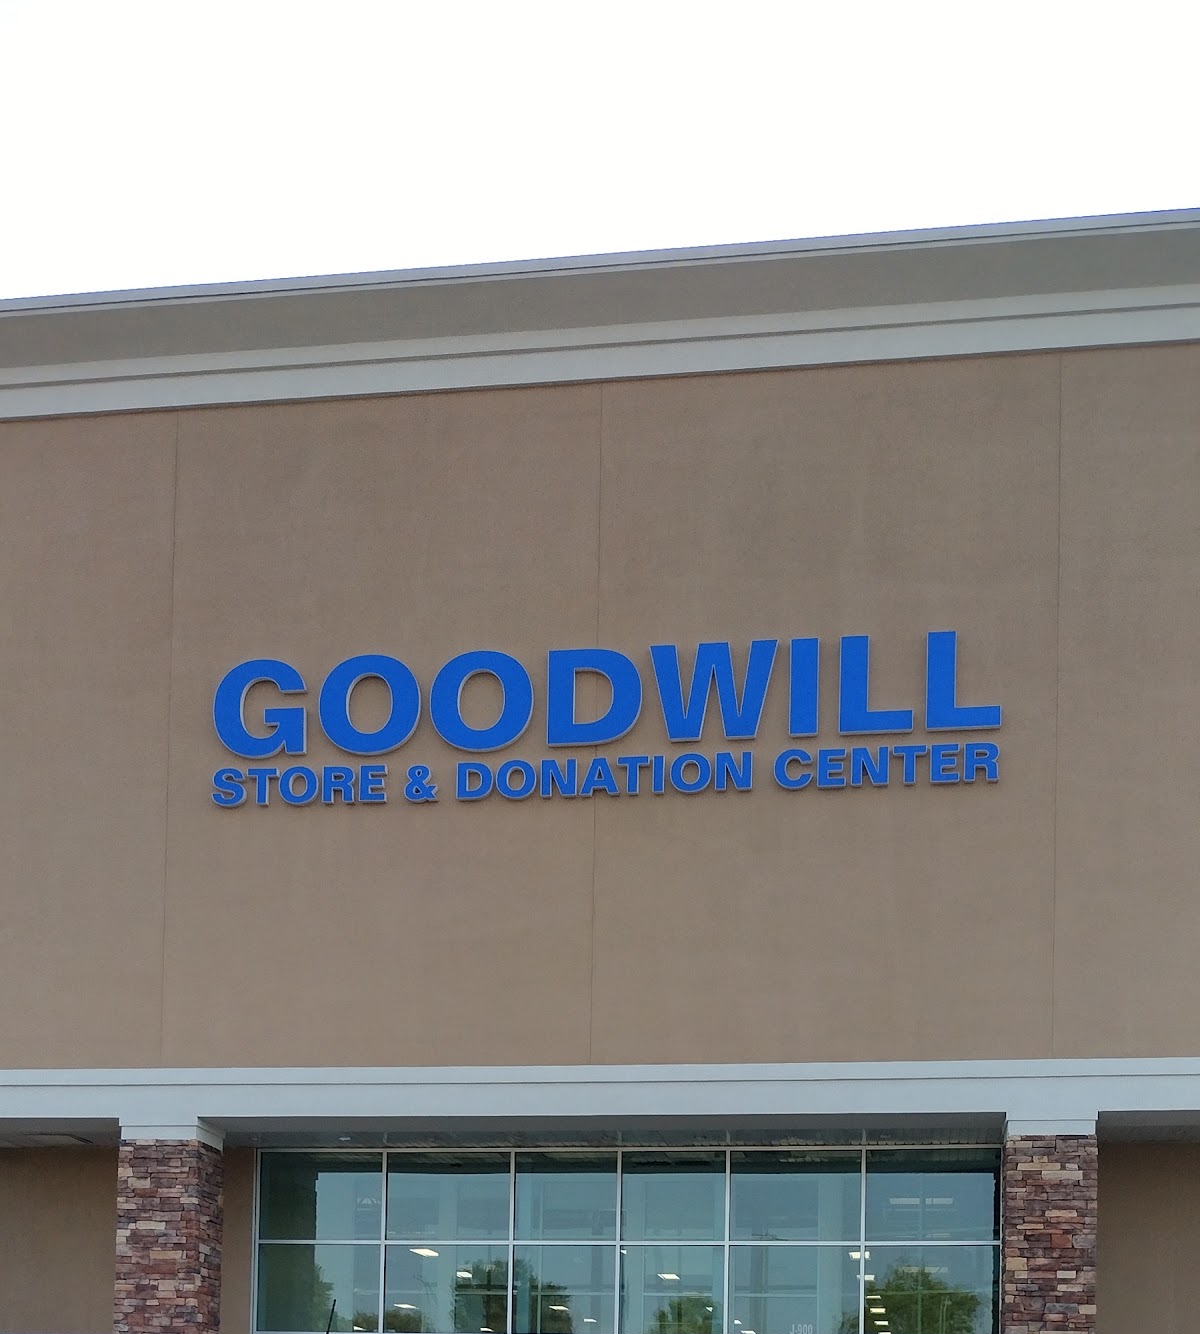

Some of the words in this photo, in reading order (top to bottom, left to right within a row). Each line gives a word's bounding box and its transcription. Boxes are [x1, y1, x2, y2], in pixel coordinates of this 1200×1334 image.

[213, 631, 1001, 759] GOODWILL
[212, 765, 388, 807] STORE
[404, 765, 438, 801] &
[456, 751, 753, 800] DONATION
[774, 743, 999, 790] CENTER
